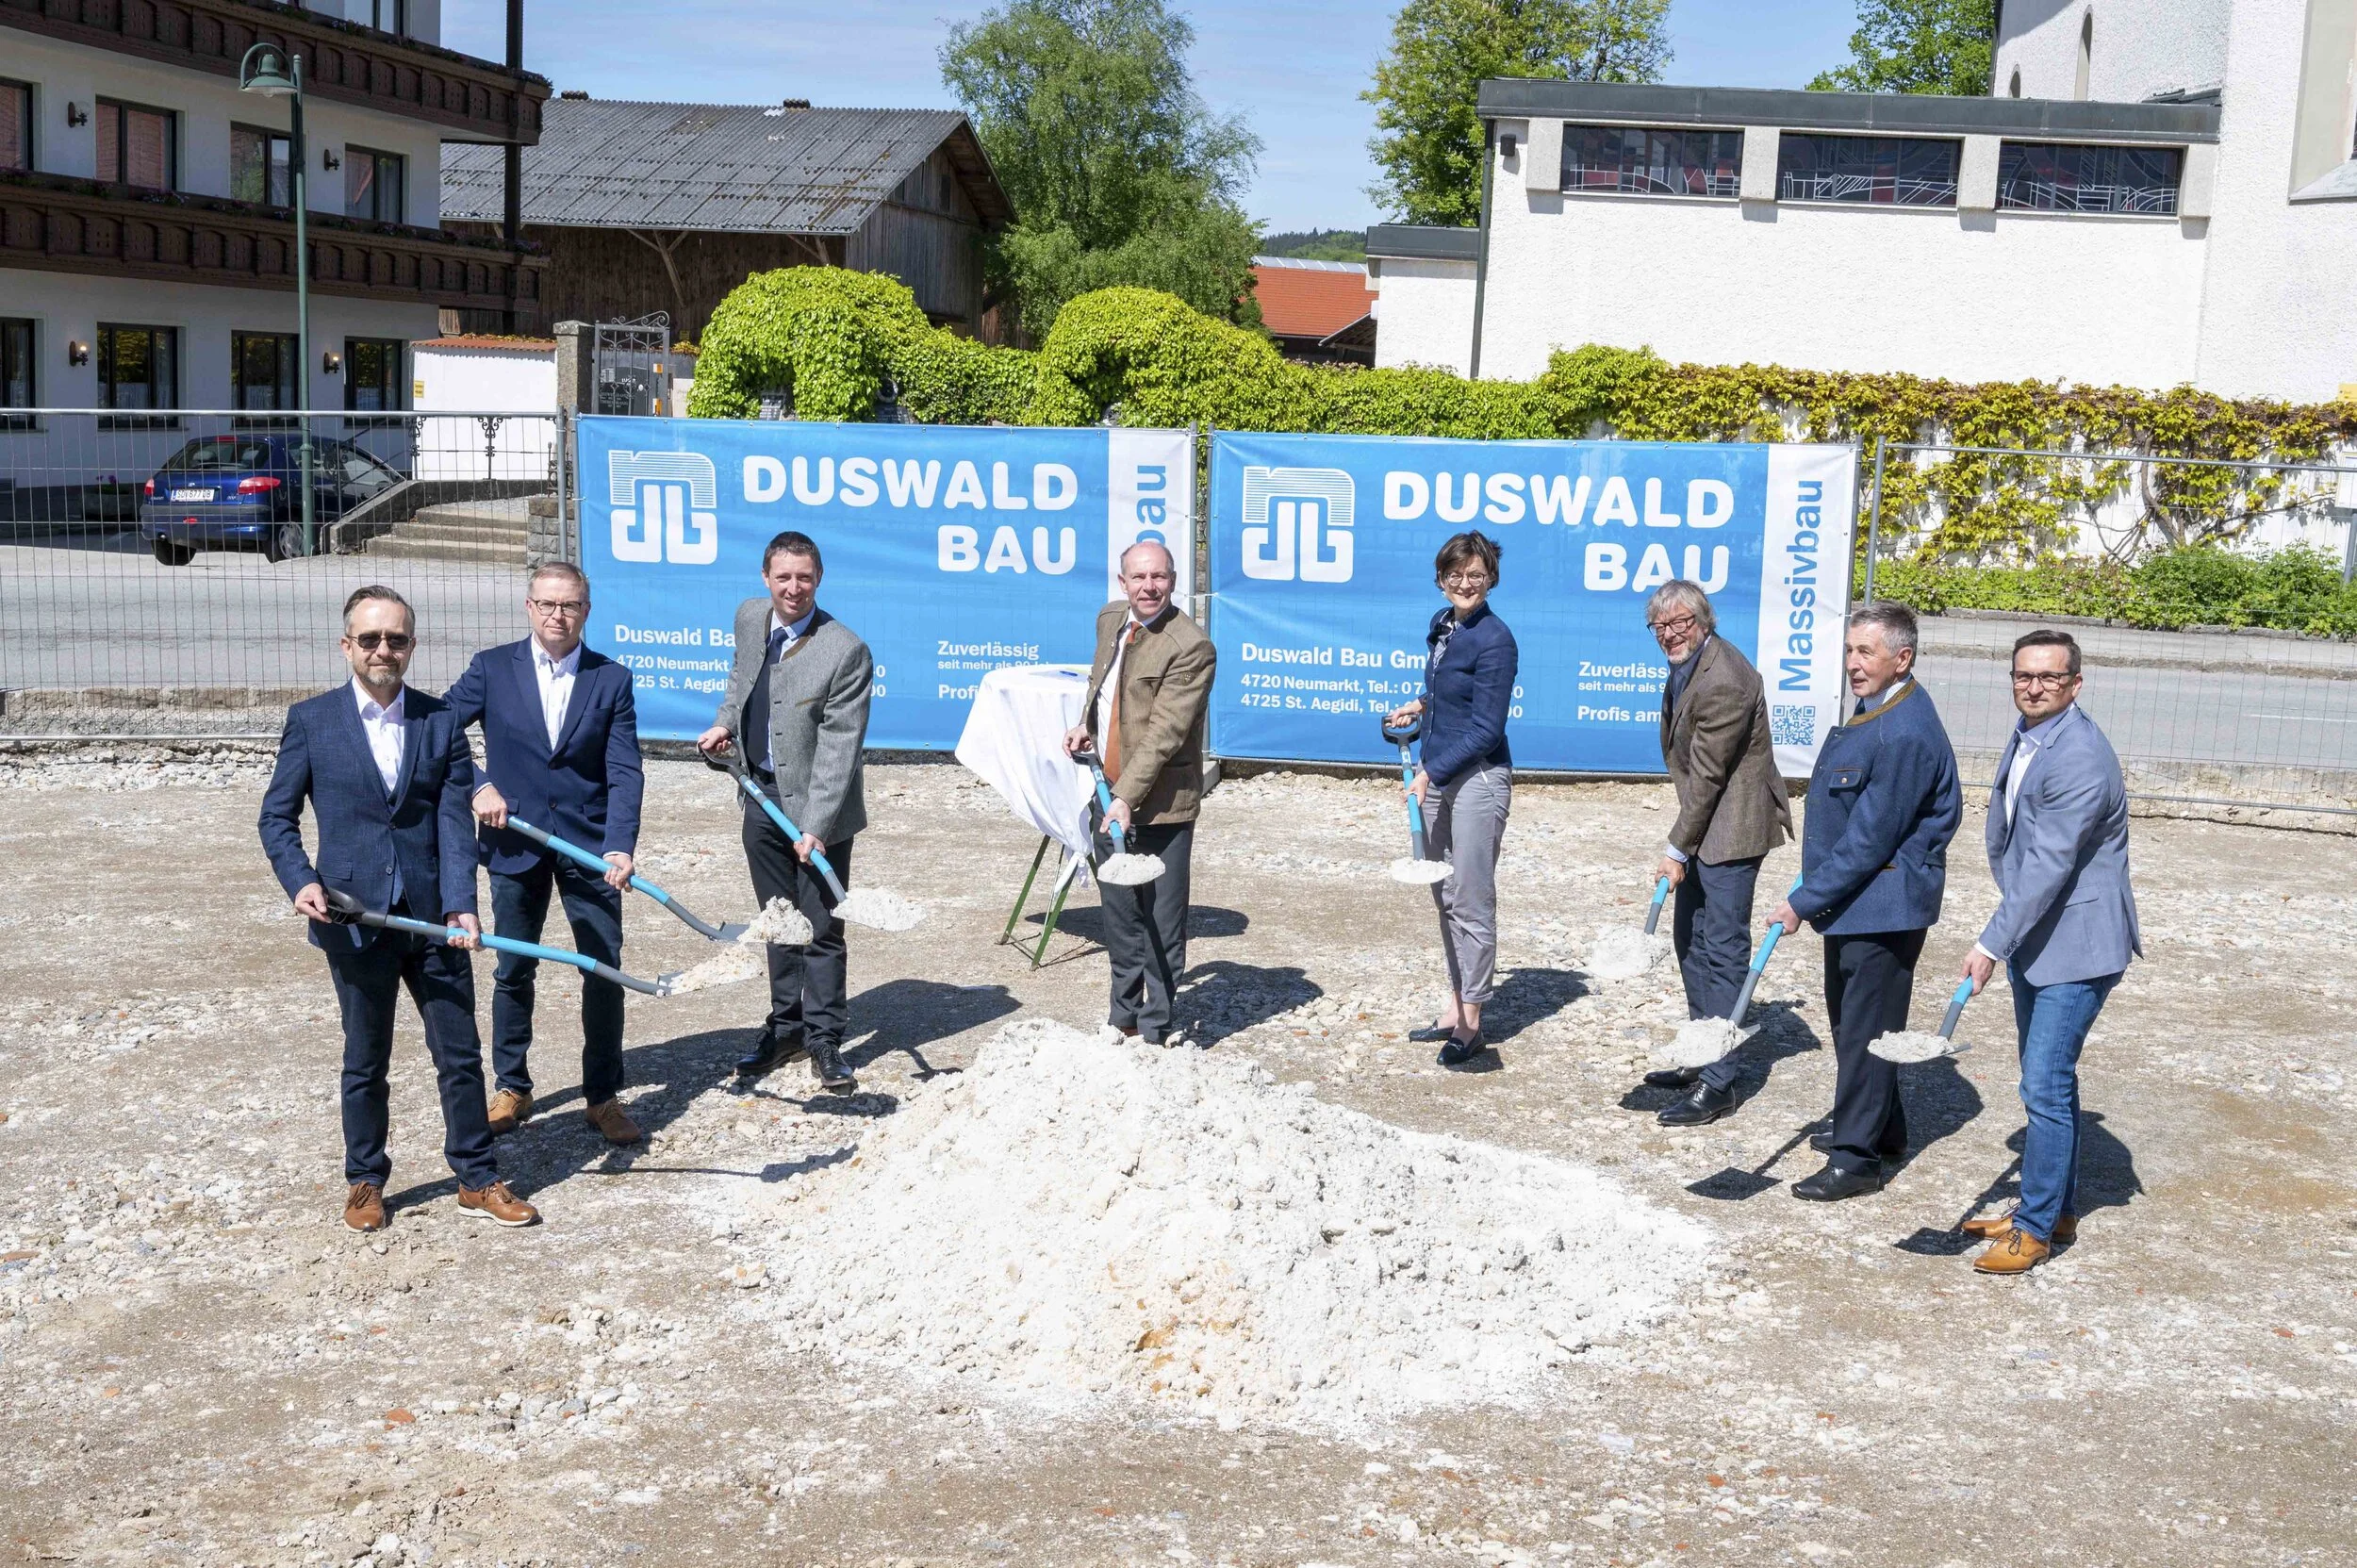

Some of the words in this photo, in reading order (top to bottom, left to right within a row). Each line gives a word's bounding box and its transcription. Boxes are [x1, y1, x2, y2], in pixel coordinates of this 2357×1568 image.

[743, 455, 1079, 511] DUSWALD
[1383, 470, 1735, 528] DUSWALD
[938, 524, 1077, 575] BAU
[1584, 542, 1730, 595] BAU
[1778, 480, 1822, 691] Massivbau
[615, 624, 701, 646] Duswald
[709, 628, 736, 648] Ba
[937, 640, 1039, 660] Zuverlässig
[1242, 642, 1333, 666] Duswald
[1341, 648, 1382, 668] Bau
[1390, 650, 1429, 669] Gm
[937, 659, 960, 669] seit
[962, 660, 992, 670] mehr
[1578, 661, 1670, 679] Zuverläss
[659, 676, 680, 689] St.
[938, 684, 979, 700] Profi
[1241, 673, 1281, 689] 4720
[1283, 676, 1364, 695] Neumarkt,
[1367, 680, 1398, 694] Tel.:
[1578, 681, 1602, 691] seit
[1604, 681, 1636, 692] mehr
[1638, 682, 1656, 693] als
[1241, 694, 1281, 708] 4725
[1285, 695, 1307, 709] St.
[1310, 697, 1363, 714] Aegidi,
[1577, 705, 1631, 721] Profis
